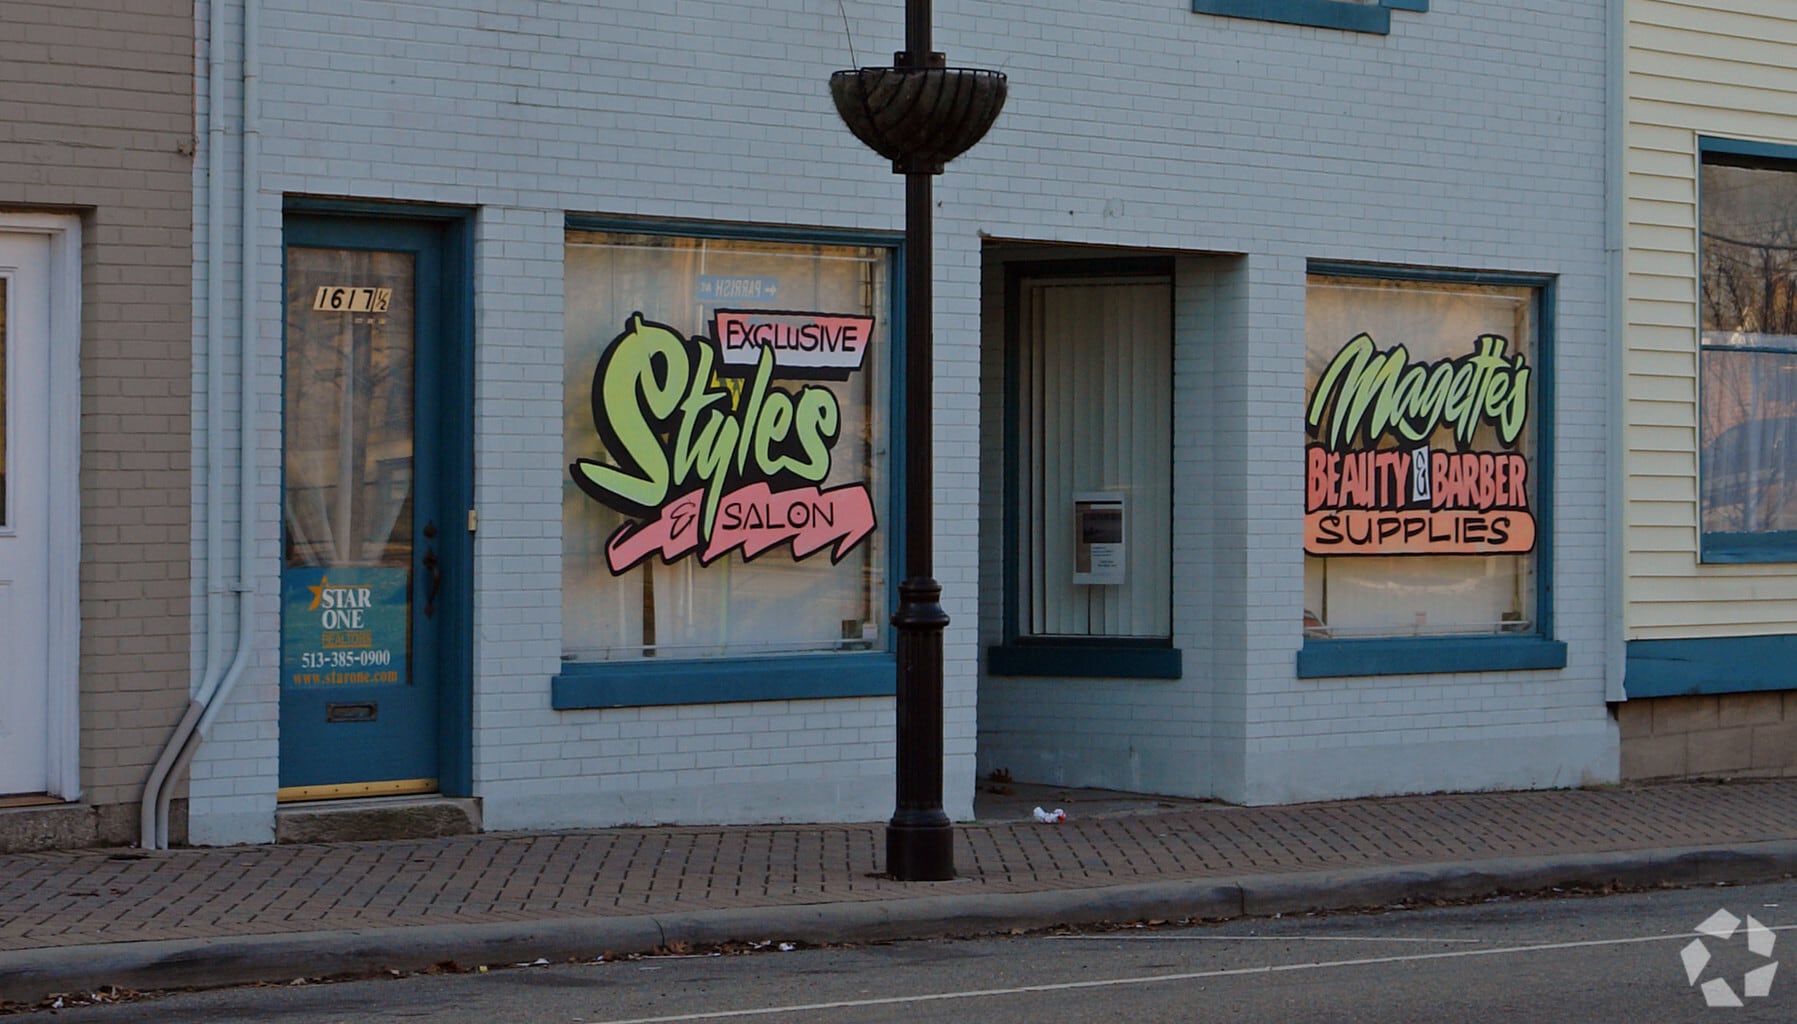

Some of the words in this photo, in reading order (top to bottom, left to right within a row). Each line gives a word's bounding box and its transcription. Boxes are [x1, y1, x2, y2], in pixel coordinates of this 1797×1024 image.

[1308, 333, 1531, 451] Magette's
[578, 314, 841, 543] Styles
[1307, 448, 1411, 511] BEAUTY
[1415, 450, 1428, 497] &
[1430, 451, 1527, 511] BARBER
[670, 496, 697, 538] &
[721, 501, 836, 530] SALON
[1315, 516, 1511, 545] SUPPLIES
[321, 588, 372, 609] STAR
[321, 609, 365, 630] ONE
[301, 650, 391, 669] 513-385-0900
[293, 670, 398, 685] www.starone.com
